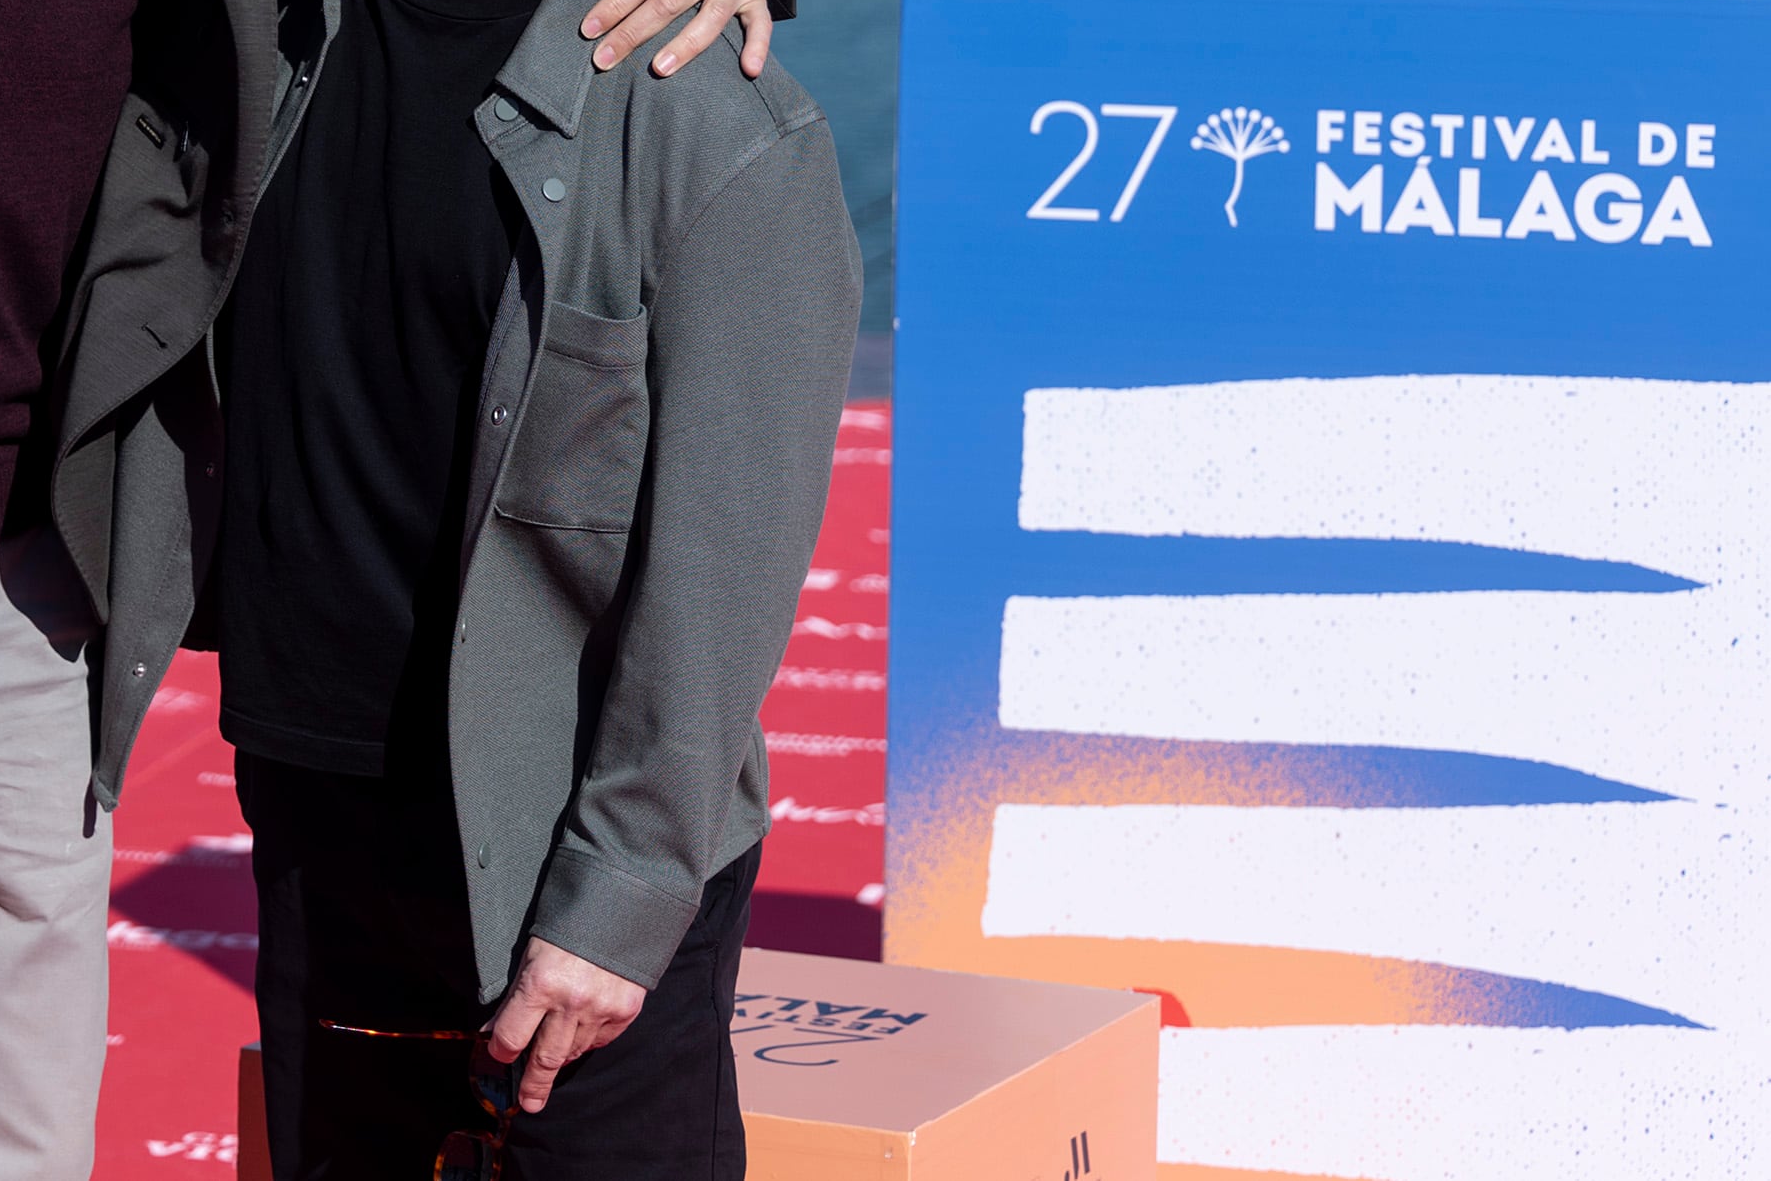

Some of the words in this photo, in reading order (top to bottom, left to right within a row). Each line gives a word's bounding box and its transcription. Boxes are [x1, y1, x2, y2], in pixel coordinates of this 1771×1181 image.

[1026, 100, 1179, 222] 27
[1315, 109, 1611, 166] FESTIVAL
[1637, 121, 1717, 169] DE
[1313, 155, 1714, 248] MÁLAGA
